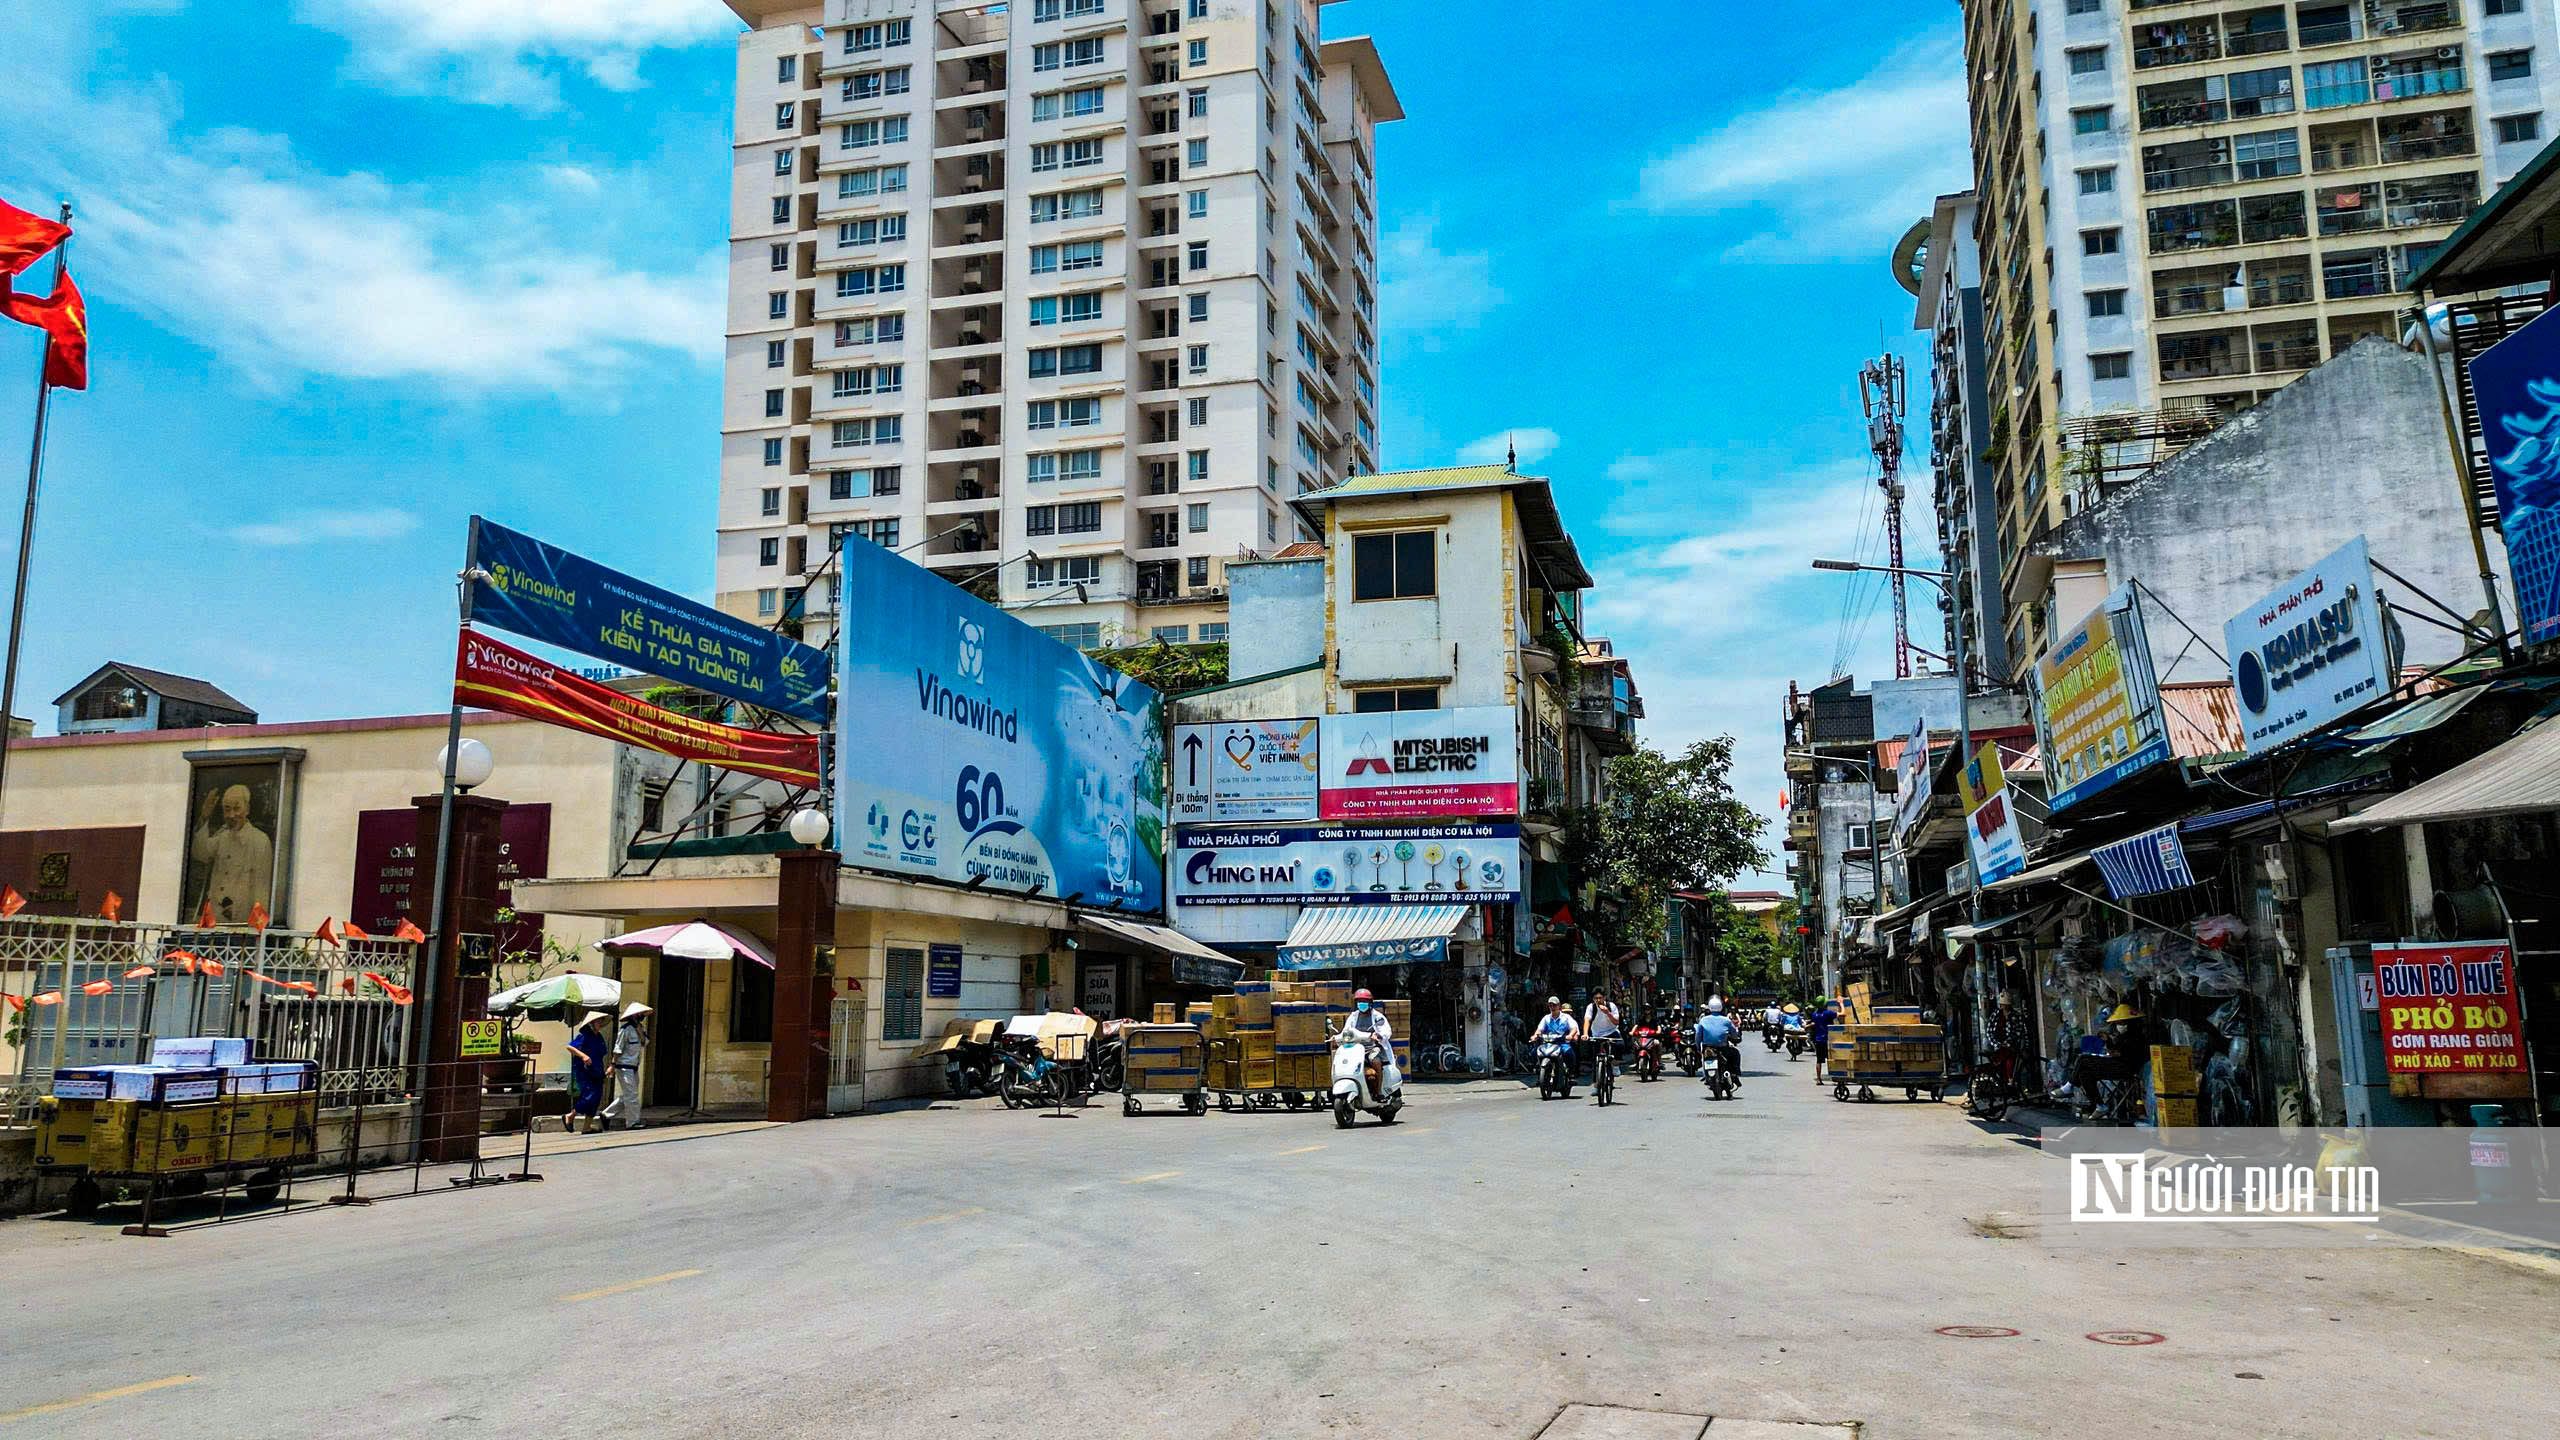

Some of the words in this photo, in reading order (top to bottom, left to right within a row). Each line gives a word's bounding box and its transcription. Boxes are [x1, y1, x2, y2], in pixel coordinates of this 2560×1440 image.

[512, 568, 576, 607] Vinawind
[677, 608, 692, 621] CÔNG
[2258, 608, 2277, 628] NHÀ
[2278, 593, 2302, 616] PHÂN
[621, 607, 644, 631] KẾ
[698, 636, 723, 659] GIÁ
[728, 646, 751, 671] TRỊ
[2262, 597, 2353, 673] KOMASU
[600, 625, 642, 654] KIẾN
[647, 641, 681, 666] TẠO
[686, 653, 738, 685] TƯƠNG
[741, 673, 764, 693] LAI
[583, 663, 622, 681] PHÁT
[916, 667, 1018, 745] Vinawind
[657, 728, 679, 744] QUỐC
[1259, 741, 1277, 751] QUỐC
[1278, 740, 1286, 750] TẾ
[1393, 736, 1489, 756] MITSUBISHI
[1259, 753, 1277, 765] VIỆT
[1278, 753, 1300, 763] MINH
[1393, 754, 1477, 773] ELECTRIC
[956, 765, 1004, 833] 60
[1176, 793, 1184, 803] Đi
[1187, 789, 1209, 804] thẳng
[1343, 799, 1365, 809] CÔNG
[1367, 800, 1377, 808] TY
[1379, 799, 1400, 808] TNHH
[1402, 798, 1416, 807] KIM
[1418, 796, 1432, 806] KHÍ
[1433, 796, 1451, 807] ĐIỆN
[1454, 796, 1466, 805] CƠ
[1467, 795, 1478, 804] HÀ
[1480, 795, 1495, 805] NỘI
[1181, 804, 1203, 814] 100m
[1188, 833, 1213, 846] NHÀ
[1216, 833, 1249, 845] PHÂN
[1252, 831, 1280, 845] PHỐI
[1318, 828, 1344, 838] CÔNG
[1346, 829, 1357, 838] TY
[1360, 828, 1383, 838] TNHH
[1385, 828, 1403, 837] KIM
[1404, 827, 1420, 837] KHÍ
[1422, 827, 1442, 838] ĐIỆN
[1445, 826, 1458, 837] CƠ
[1460, 826, 1474, 836] HÀ
[1476, 826, 1492, 836] NỘI
[966, 857, 992, 879] CÙNG
[993, 865, 1009, 882] GIA
[1010, 865, 1031, 885] ĐÌNH
[1032, 871, 1050, 889] VIỆT
[1186, 850, 1256, 885] CHING
[1260, 866, 1294, 883] HAI
[1390, 894, 1403, 902] TEL:
[1404, 894, 1418, 902] 0913
[1421, 894, 1429, 902] 09
[1465, 893, 1477, 901] 035
[1479, 893, 1492, 901] 969
[1291, 948, 1331, 963] QUẠT
[1335, 945, 1371, 960] ĐIỆN
[1375, 943, 1405, 956] CAO
[1090, 975, 1109, 989] SỬA
[2379, 958, 2426, 997] BÚN
[2427, 955, 2459, 997] BÒ
[2461, 951, 2507, 996] HUẾ
[1086, 991, 1112, 1005] CHỮA
[2391, 998, 2455, 1030] PHỞ
[2392, 1034, 2426, 1049] CƠM
[2430, 1034, 2471, 1048] RANG
[2475, 1031, 2514, 1048] GIÒN
[2394, 1050, 2420, 1068] PHỞ
[2424, 1052, 2450, 1068] XÀO
[2489, 1052, 2517, 1068] XÀO
